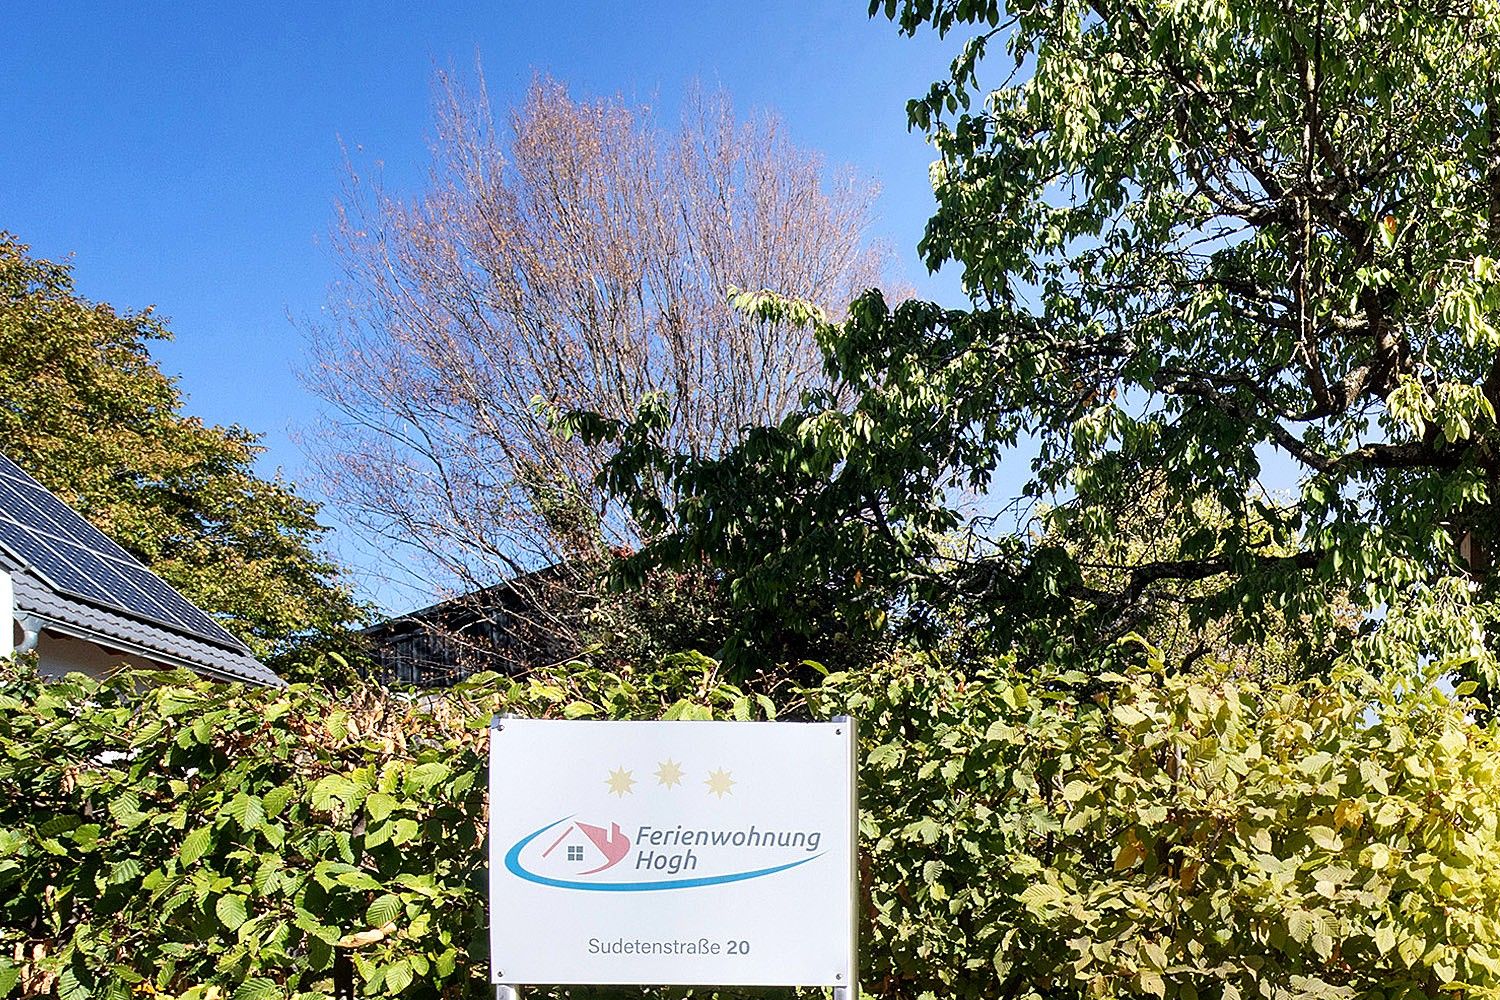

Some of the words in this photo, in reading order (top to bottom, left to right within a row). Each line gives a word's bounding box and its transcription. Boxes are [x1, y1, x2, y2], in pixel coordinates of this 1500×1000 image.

[635, 825, 821, 851] Ferienwohnung
[635, 849, 697, 875] Hogh
[588, 938, 720, 955] Sudetenstraße
[727, 940, 750, 955] 20
